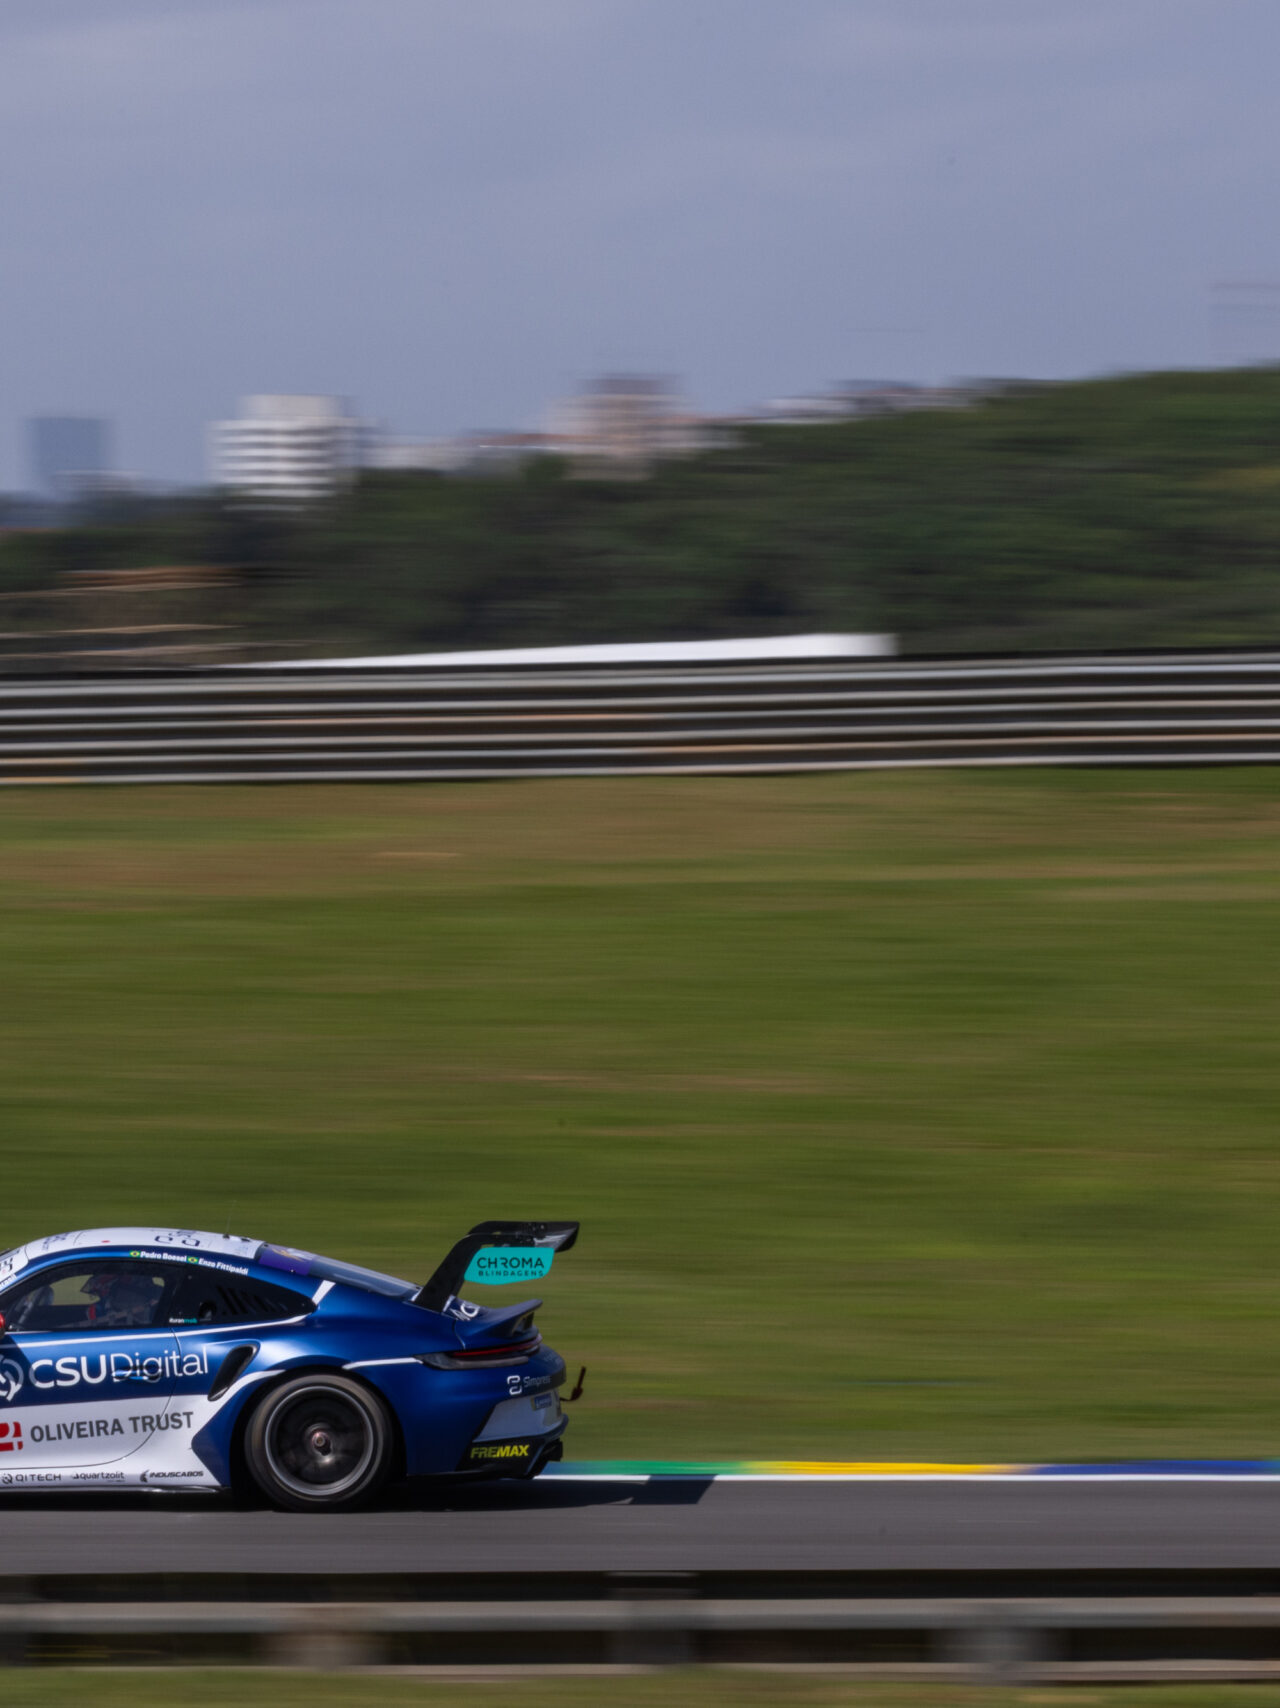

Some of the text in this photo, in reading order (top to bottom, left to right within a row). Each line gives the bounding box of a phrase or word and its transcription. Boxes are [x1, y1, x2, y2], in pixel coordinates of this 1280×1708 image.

[140, 1251, 161, 1259] Pedro
[198, 1259, 249, 1275] Enzo Fittipaldi
[477, 1257, 544, 1269] CHROMA
[29, 1346, 209, 1389] CSUDigital
[30, 1411, 194, 1442] OLIVEIRA TRUST
[470, 1444, 530, 1459] FREMAX
